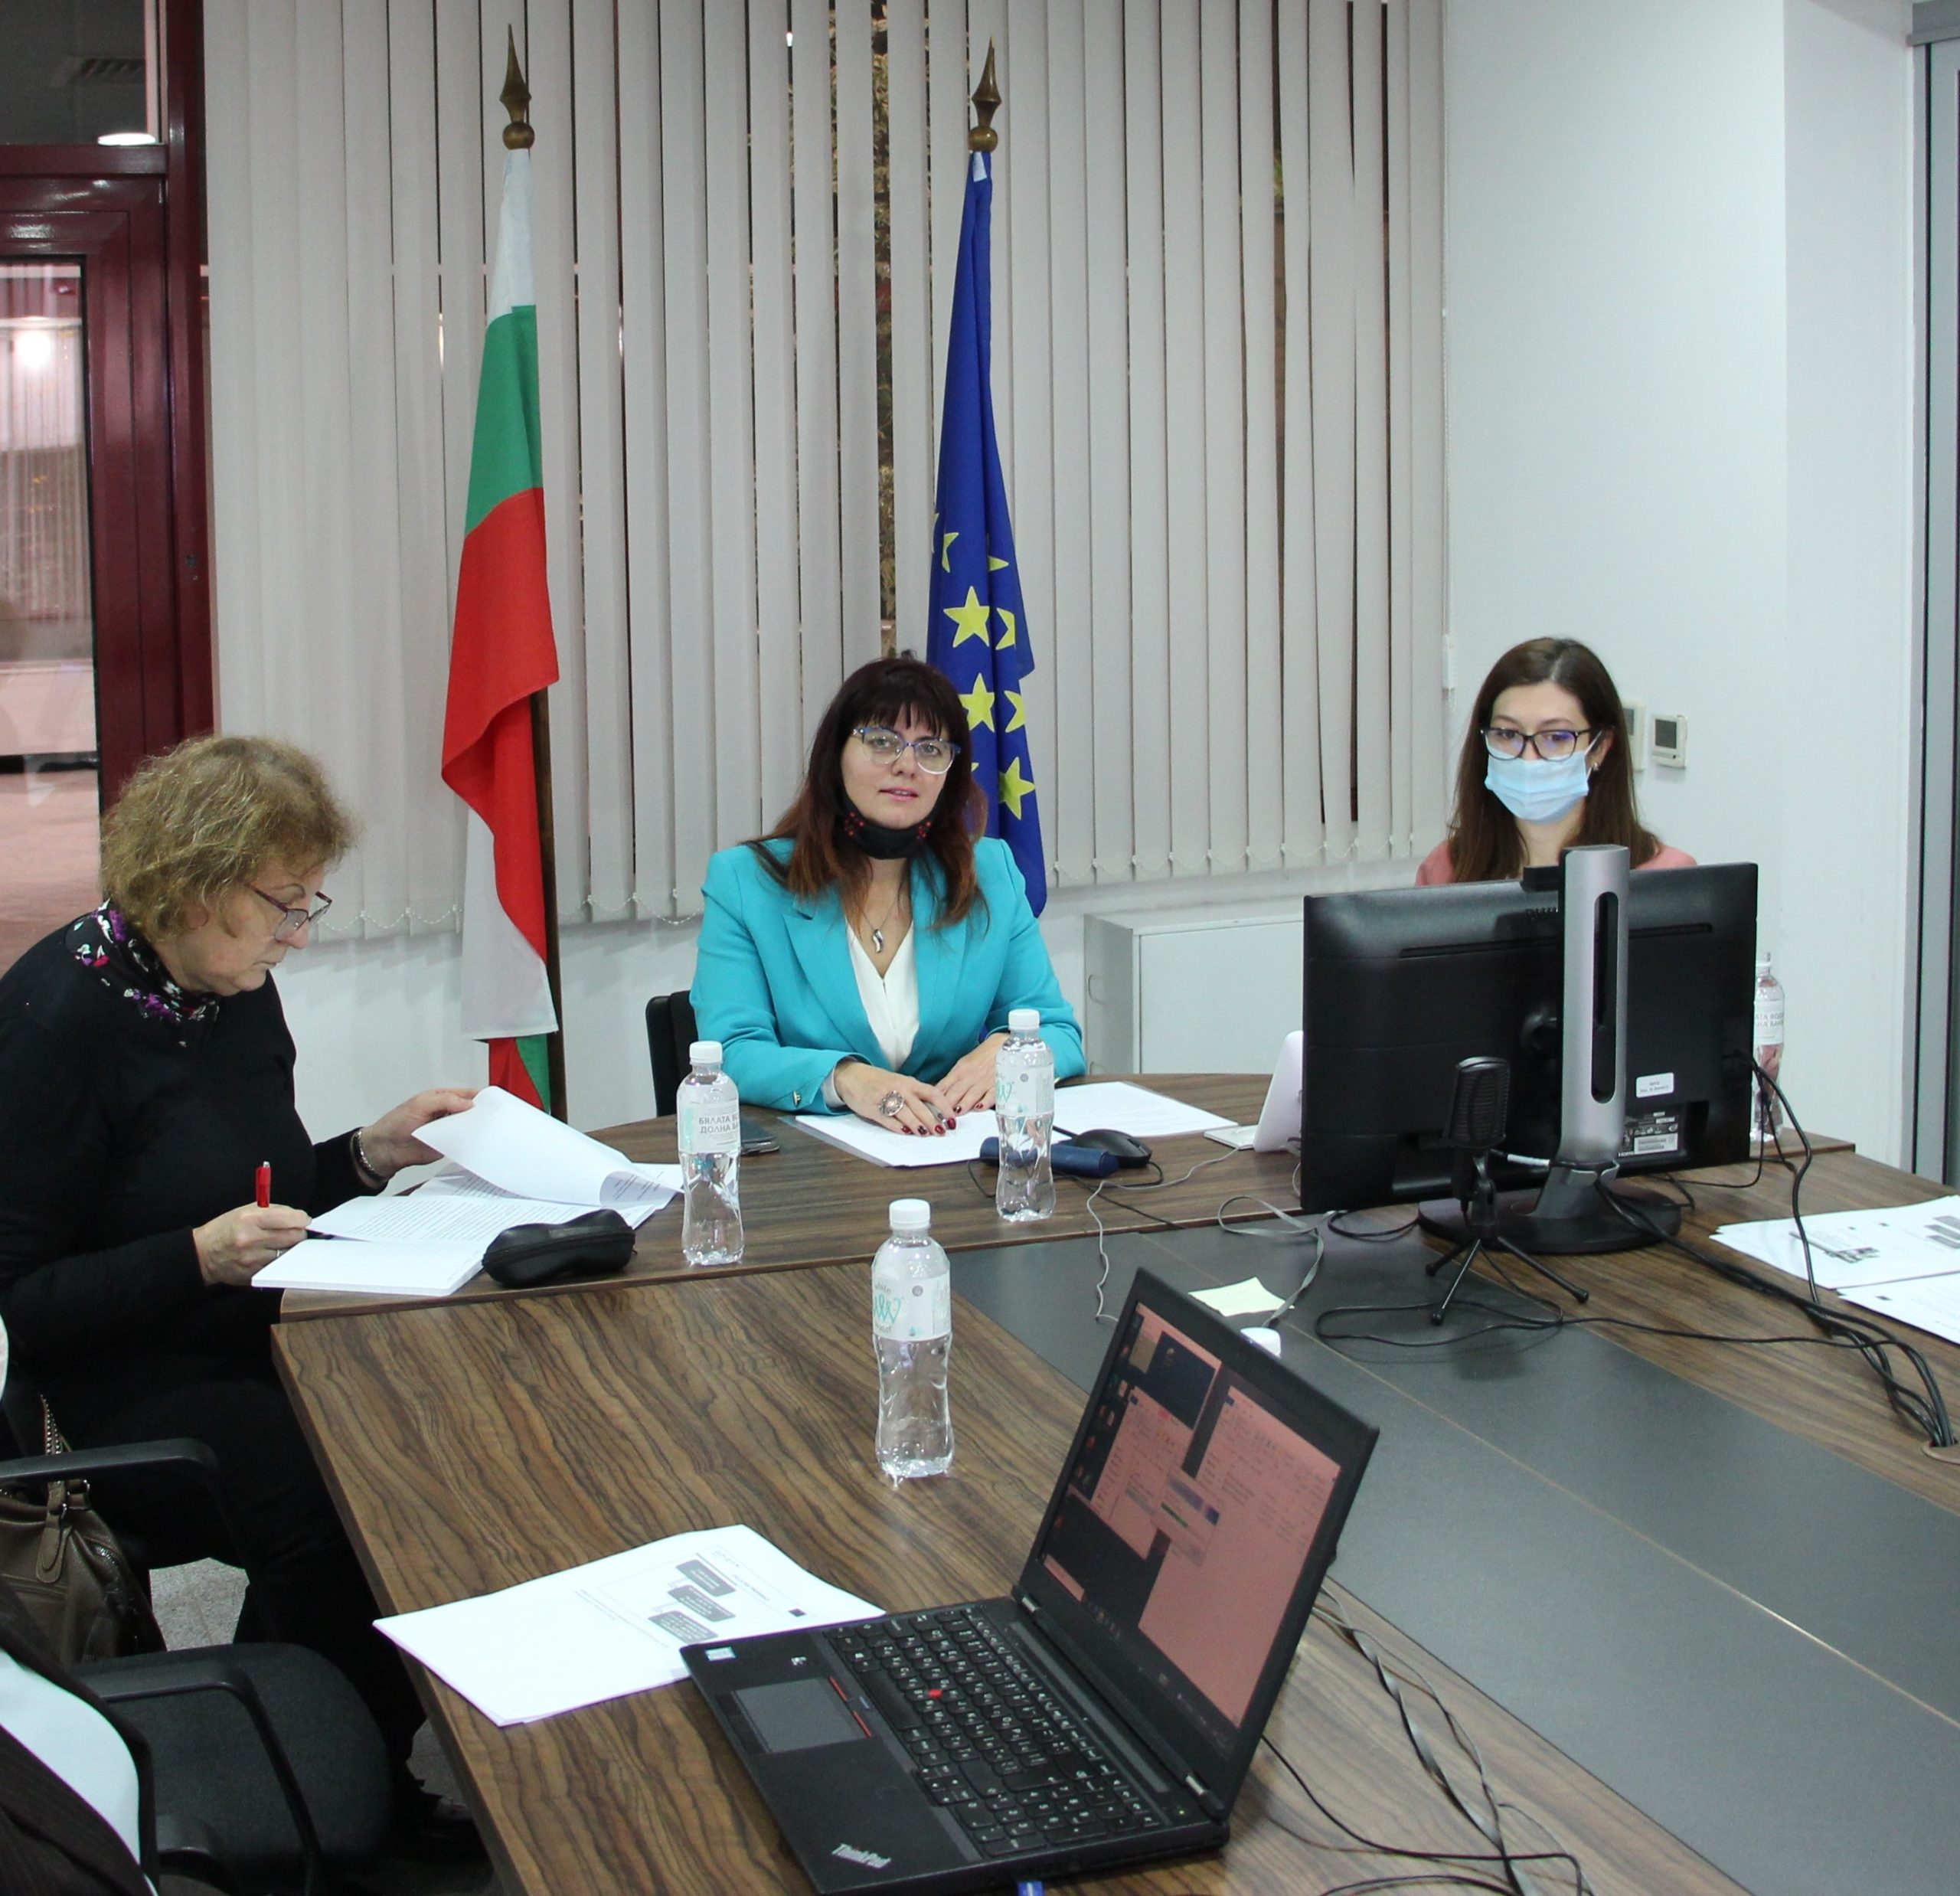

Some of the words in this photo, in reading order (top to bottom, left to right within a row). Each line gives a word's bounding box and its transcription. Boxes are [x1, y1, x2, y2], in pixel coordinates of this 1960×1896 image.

[699, 1116, 731, 1125] БЯЛАТА
[701, 1124, 731, 1133] ДОЛНА
[831, 1843, 891, 1868] ThinkPad
